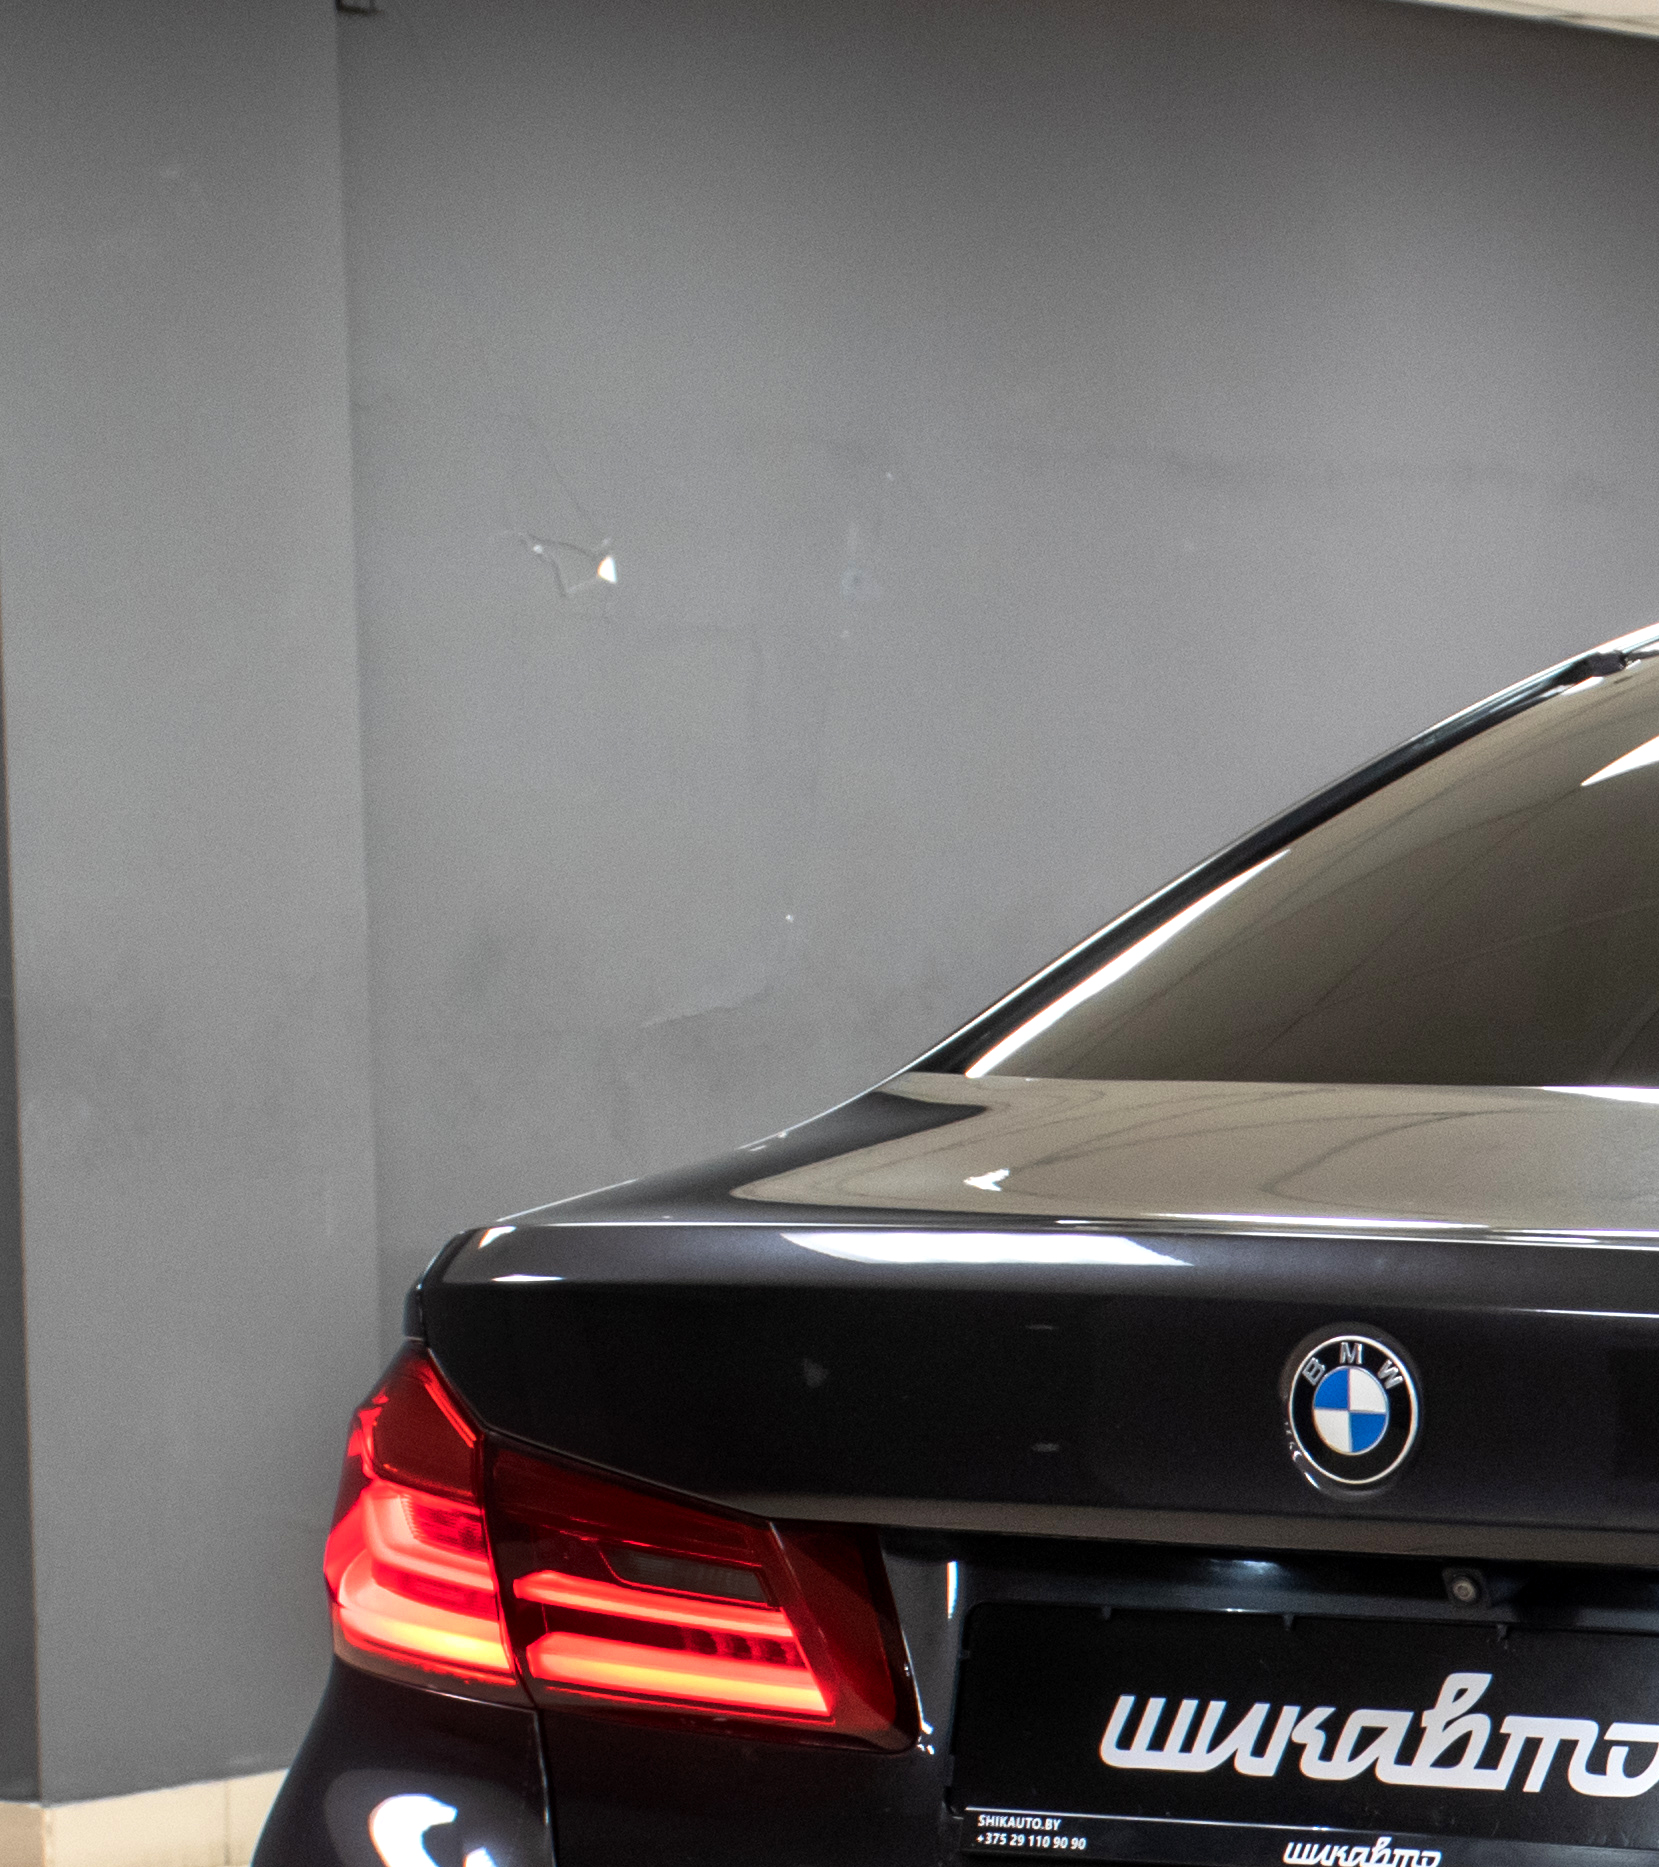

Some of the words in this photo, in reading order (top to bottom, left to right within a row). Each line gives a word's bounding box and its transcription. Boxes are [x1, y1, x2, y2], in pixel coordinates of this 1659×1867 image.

[1302, 1341, 1404, 1390] BMW
[977, 1815, 1062, 1831] SHIKAUTO.BY
[976, 1832, 1008, 1846] +375
[1009, 1833, 1026, 1847] 29
[1028, 1835, 1051, 1848] 110
[1053, 1836, 1069, 1849] 90
[1070, 1837, 1087, 1850] 90
